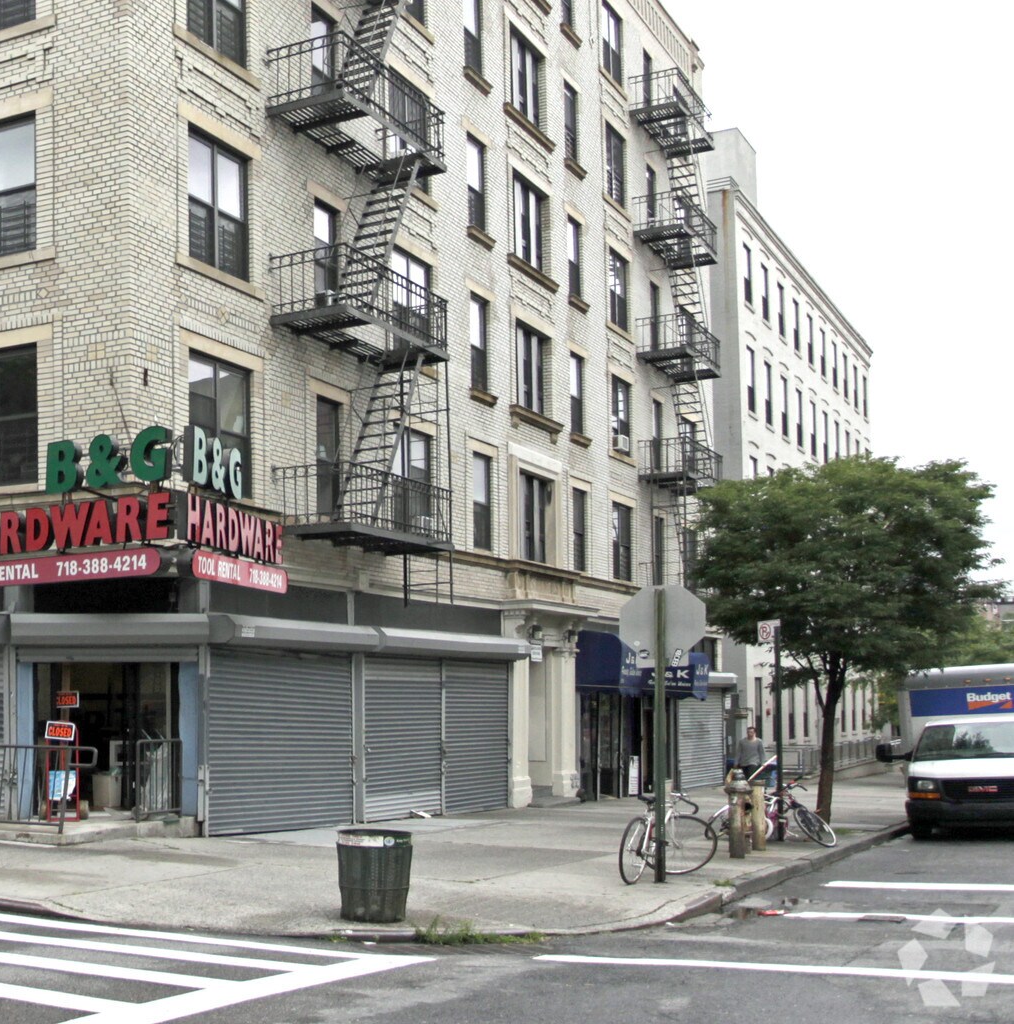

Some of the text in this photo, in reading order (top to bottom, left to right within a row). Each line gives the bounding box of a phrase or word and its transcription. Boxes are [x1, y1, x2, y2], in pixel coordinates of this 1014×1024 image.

[46, 426, 169, 494] B&G
[193, 426, 243, 500] B&G
[187, 492, 283, 565] HARDWARE
[56, 554, 147, 577] 718-388-4214
[198, 556, 283, 589] TOOL RENTAL 718-388-4214
[966, 691, 1012, 703] Budget
[48, 726, 72, 737] CLOSED
